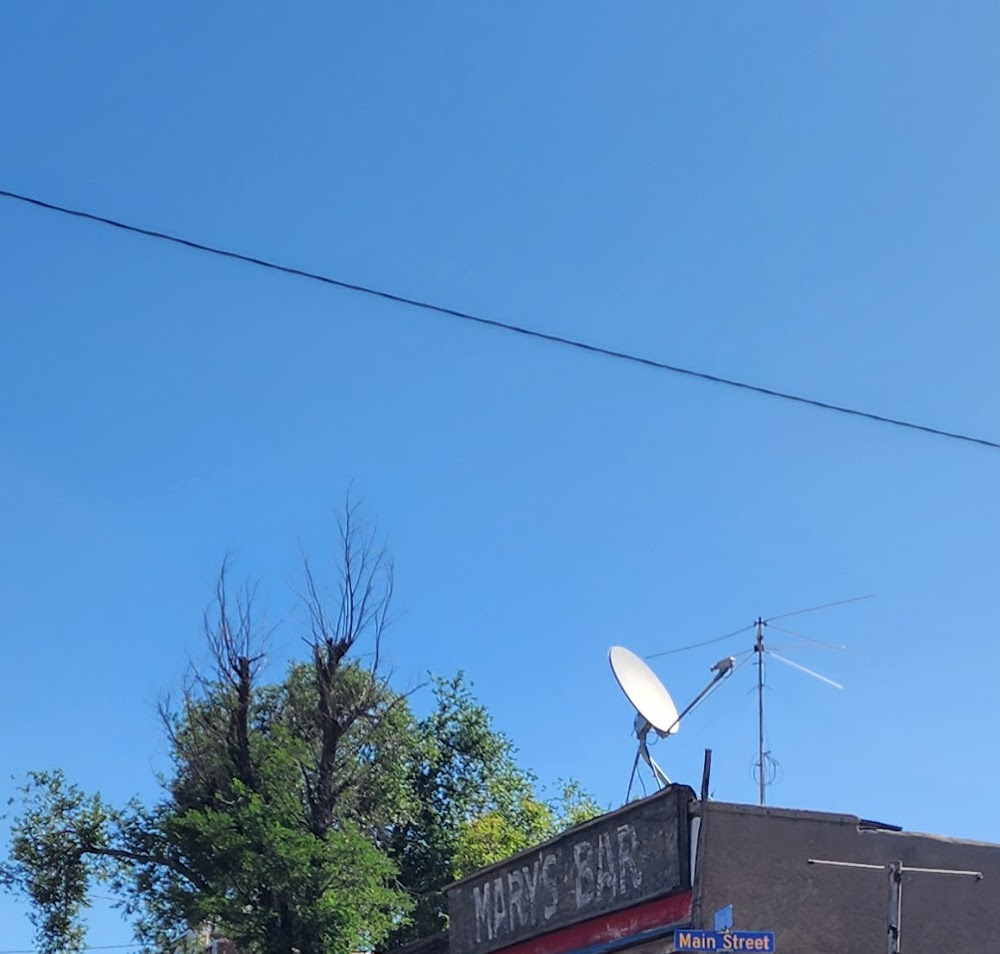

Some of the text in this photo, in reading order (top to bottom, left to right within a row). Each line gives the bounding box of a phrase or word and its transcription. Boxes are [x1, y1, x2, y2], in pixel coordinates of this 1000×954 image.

[472, 824, 643, 943] MARY'S BAR
[679, 932, 770, 950] Main Street
